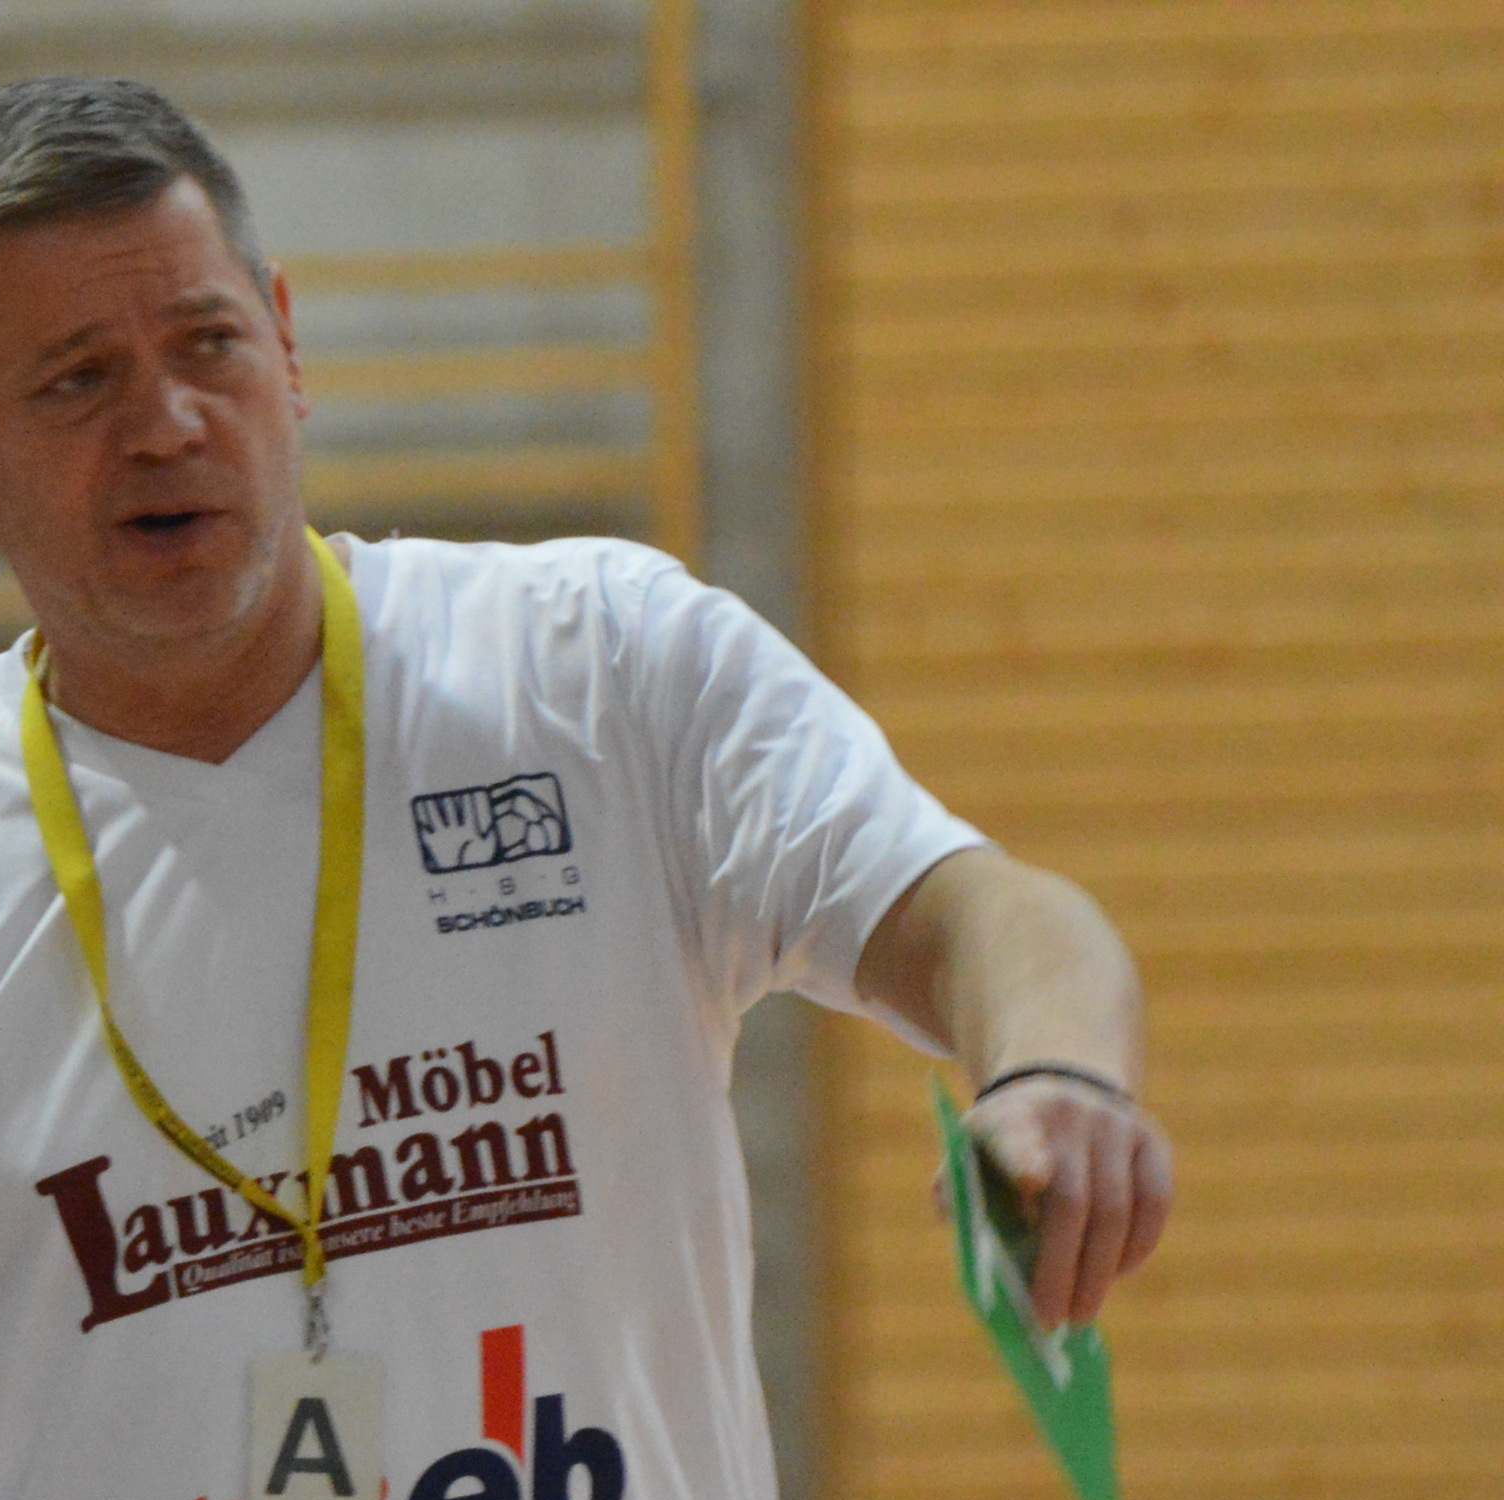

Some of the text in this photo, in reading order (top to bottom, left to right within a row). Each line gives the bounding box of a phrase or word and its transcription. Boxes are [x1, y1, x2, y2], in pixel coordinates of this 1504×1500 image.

[436, 896, 586, 934] SCHÖNBUCH
[351, 1029, 567, 1129] Möbel
[34, 1111, 578, 1335] Lauxmann
[265, 1397, 355, 1497] A
